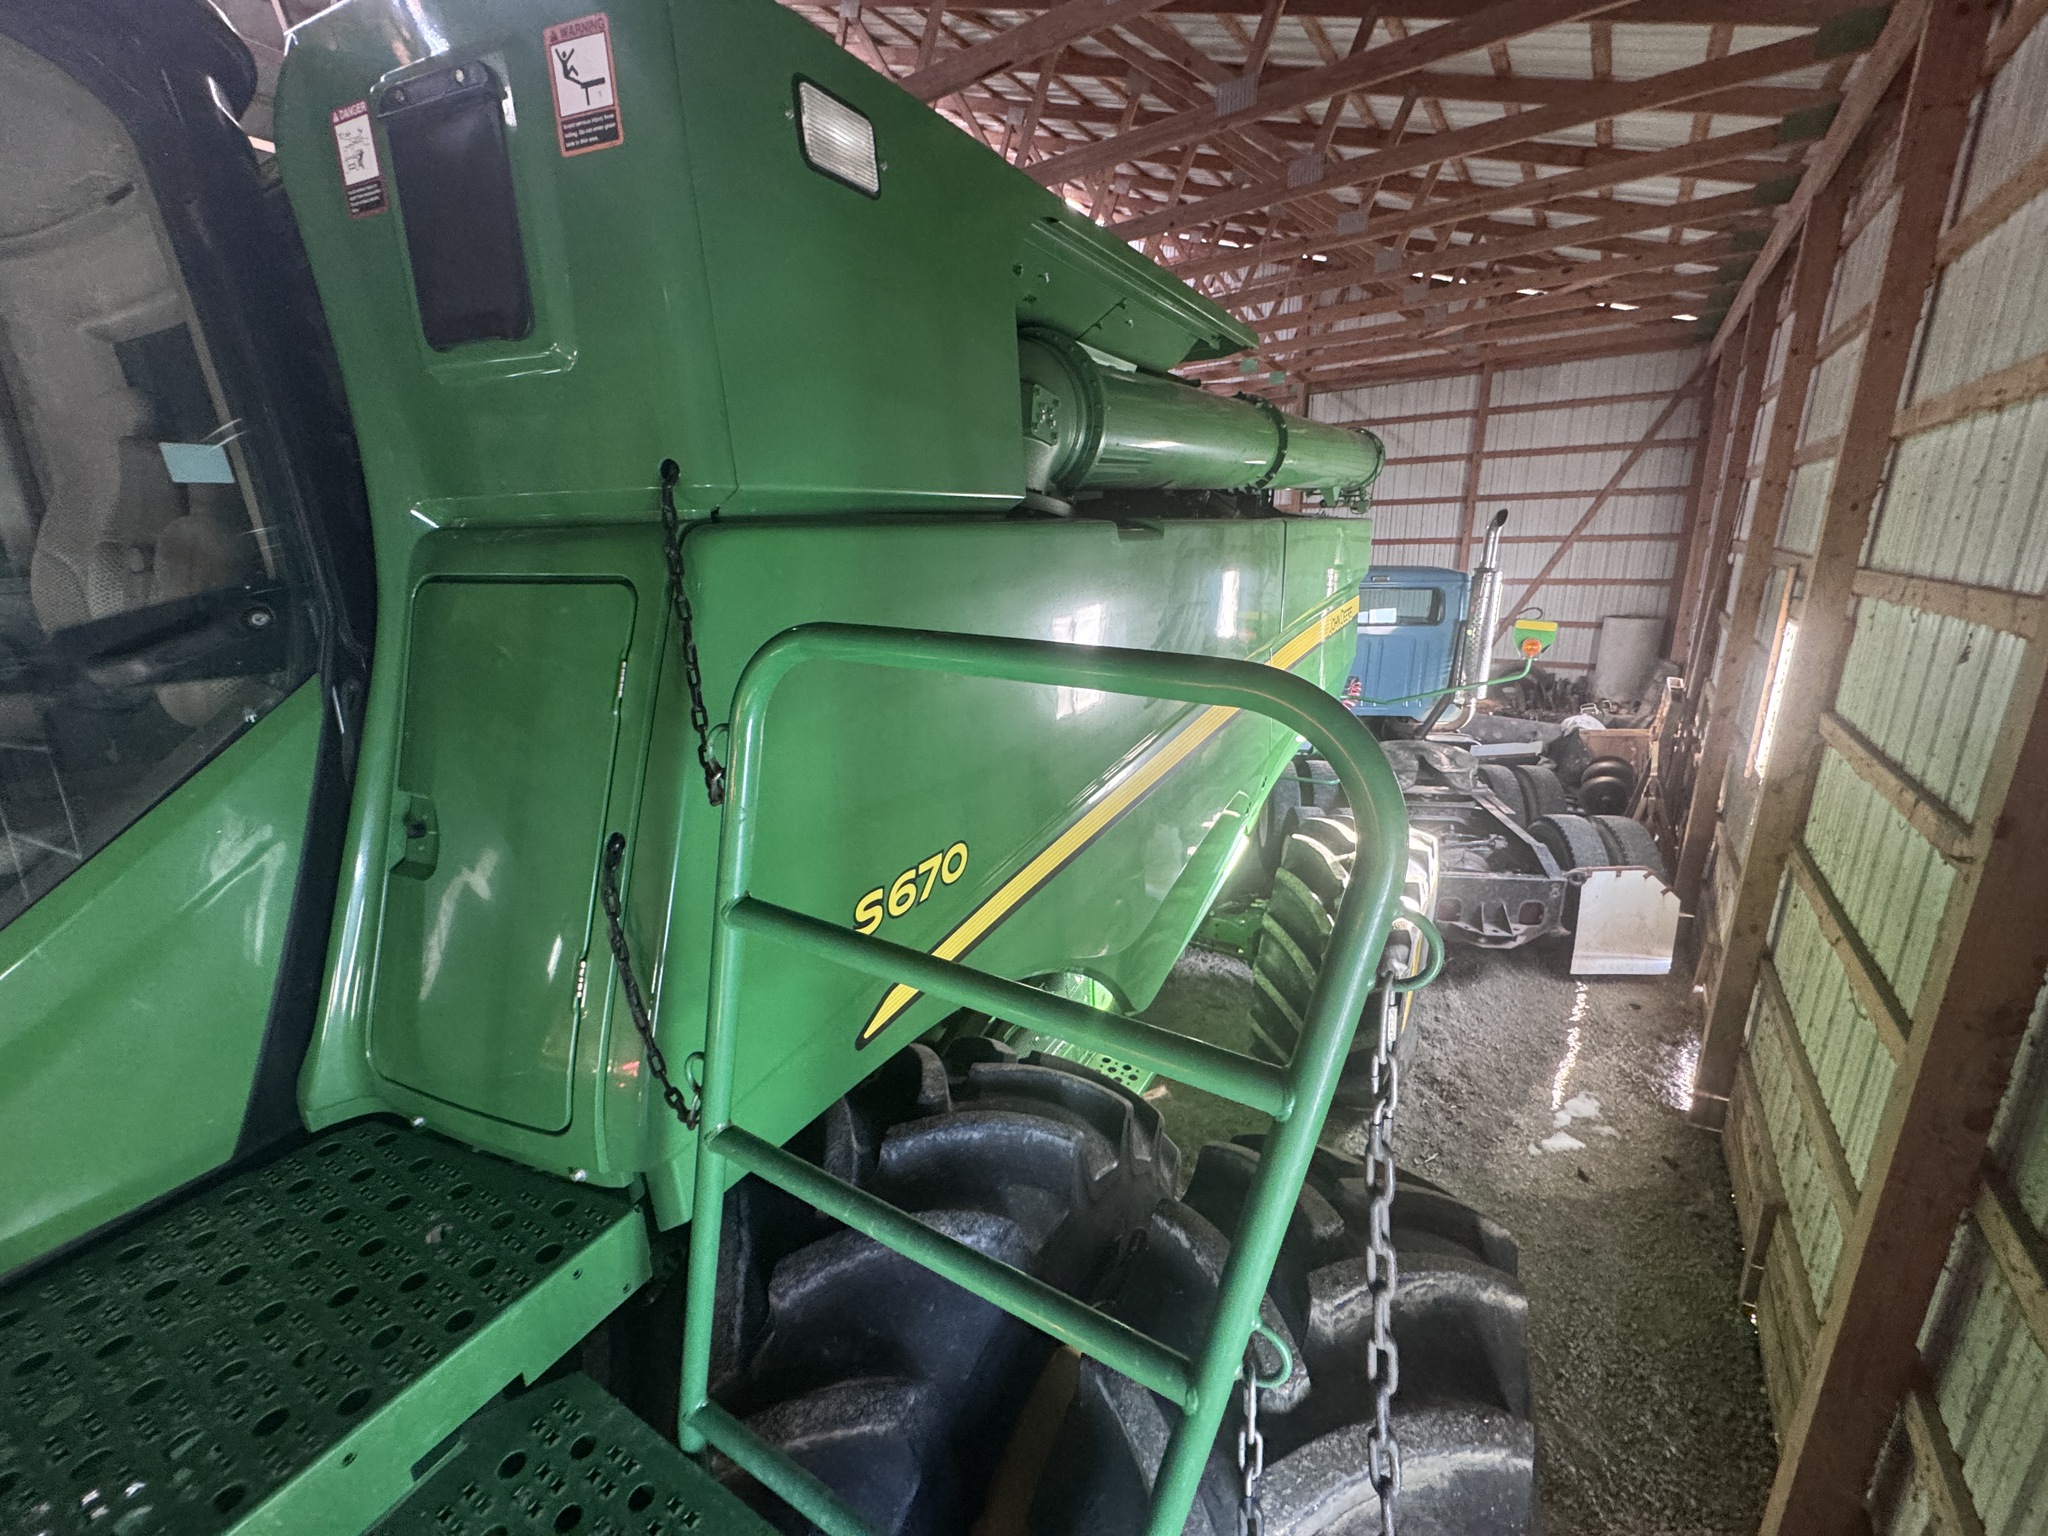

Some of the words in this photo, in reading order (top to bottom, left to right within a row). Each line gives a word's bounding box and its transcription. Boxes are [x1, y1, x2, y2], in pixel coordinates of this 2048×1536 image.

[559, 17, 606, 38] WARNING
[338, 100, 368, 121] DANGER
[853, 840, 969, 936] S670
